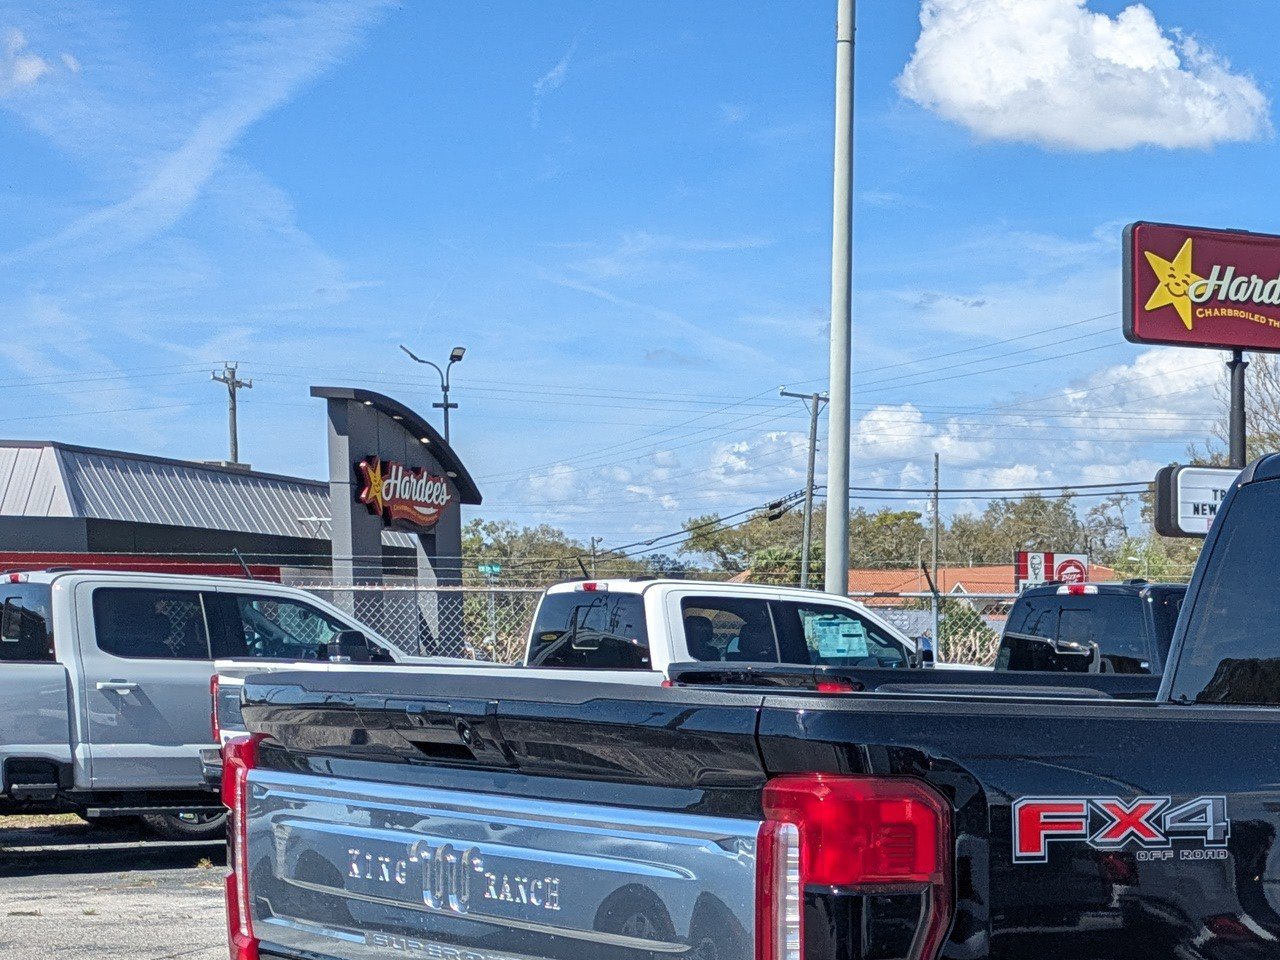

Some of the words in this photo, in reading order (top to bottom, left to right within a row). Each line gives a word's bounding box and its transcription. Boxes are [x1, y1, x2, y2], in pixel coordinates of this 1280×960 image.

[1196, 308, 1267, 324] CHARBROILED
[382, 465, 451, 506] Hardee's
[1193, 503, 1217, 516] NEW
[1012, 796, 1230, 863] FX4
[1136, 849, 1174, 861] OFF
[1180, 849, 1228, 860] ROAD
[348, 848, 407, 885] KING
[484, 872, 561, 911] RANCH
